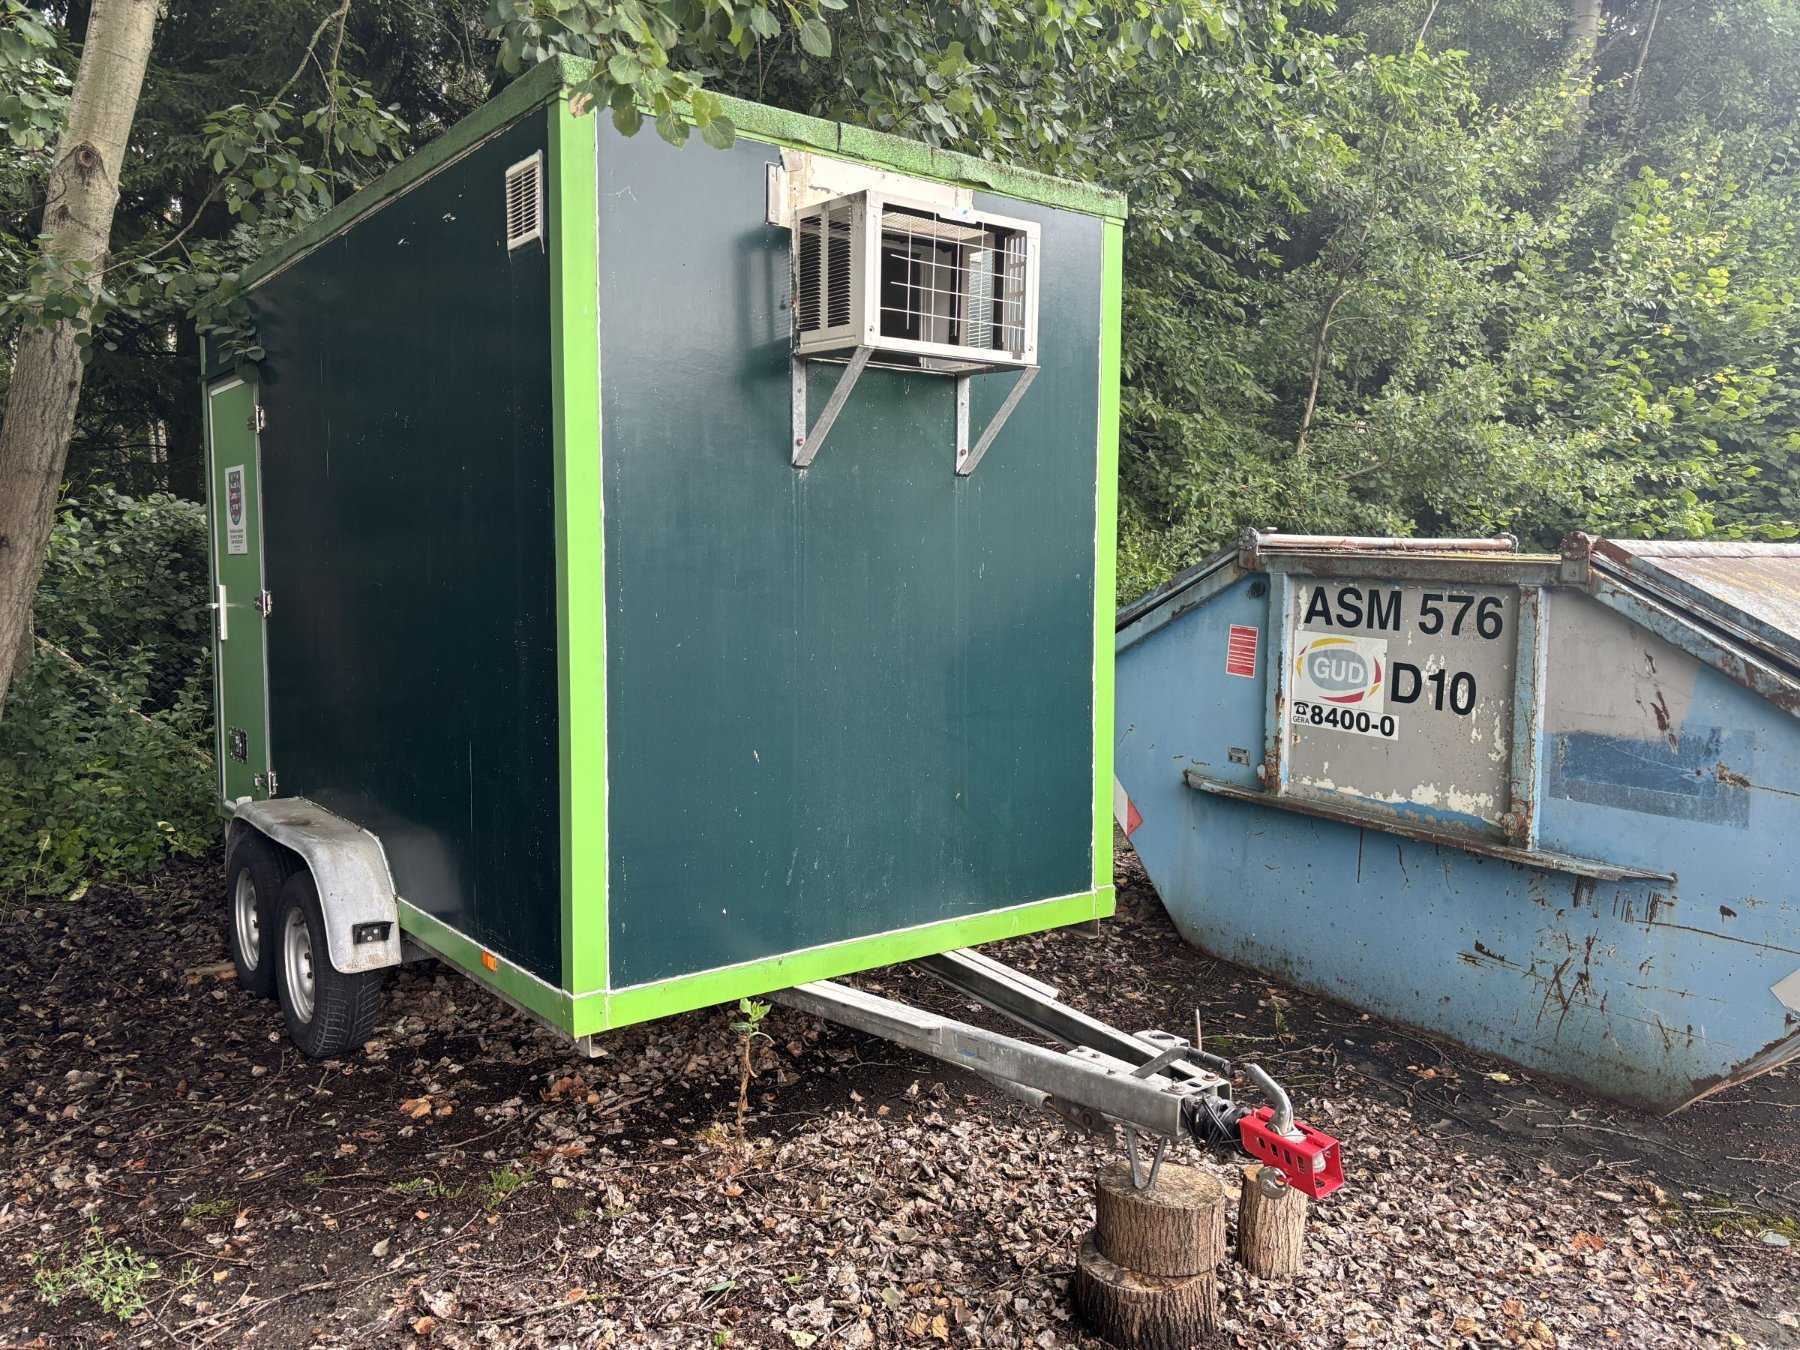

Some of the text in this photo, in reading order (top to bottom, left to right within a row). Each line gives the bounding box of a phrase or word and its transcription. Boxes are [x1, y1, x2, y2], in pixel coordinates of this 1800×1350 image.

[1304, 586, 1503, 640] ASM 576
[1313, 656, 1364, 684] GUD
[1390, 662, 1477, 715] D10
[1293, 715, 1309, 724] GERA
[1310, 705, 1394, 737] 8400-0
